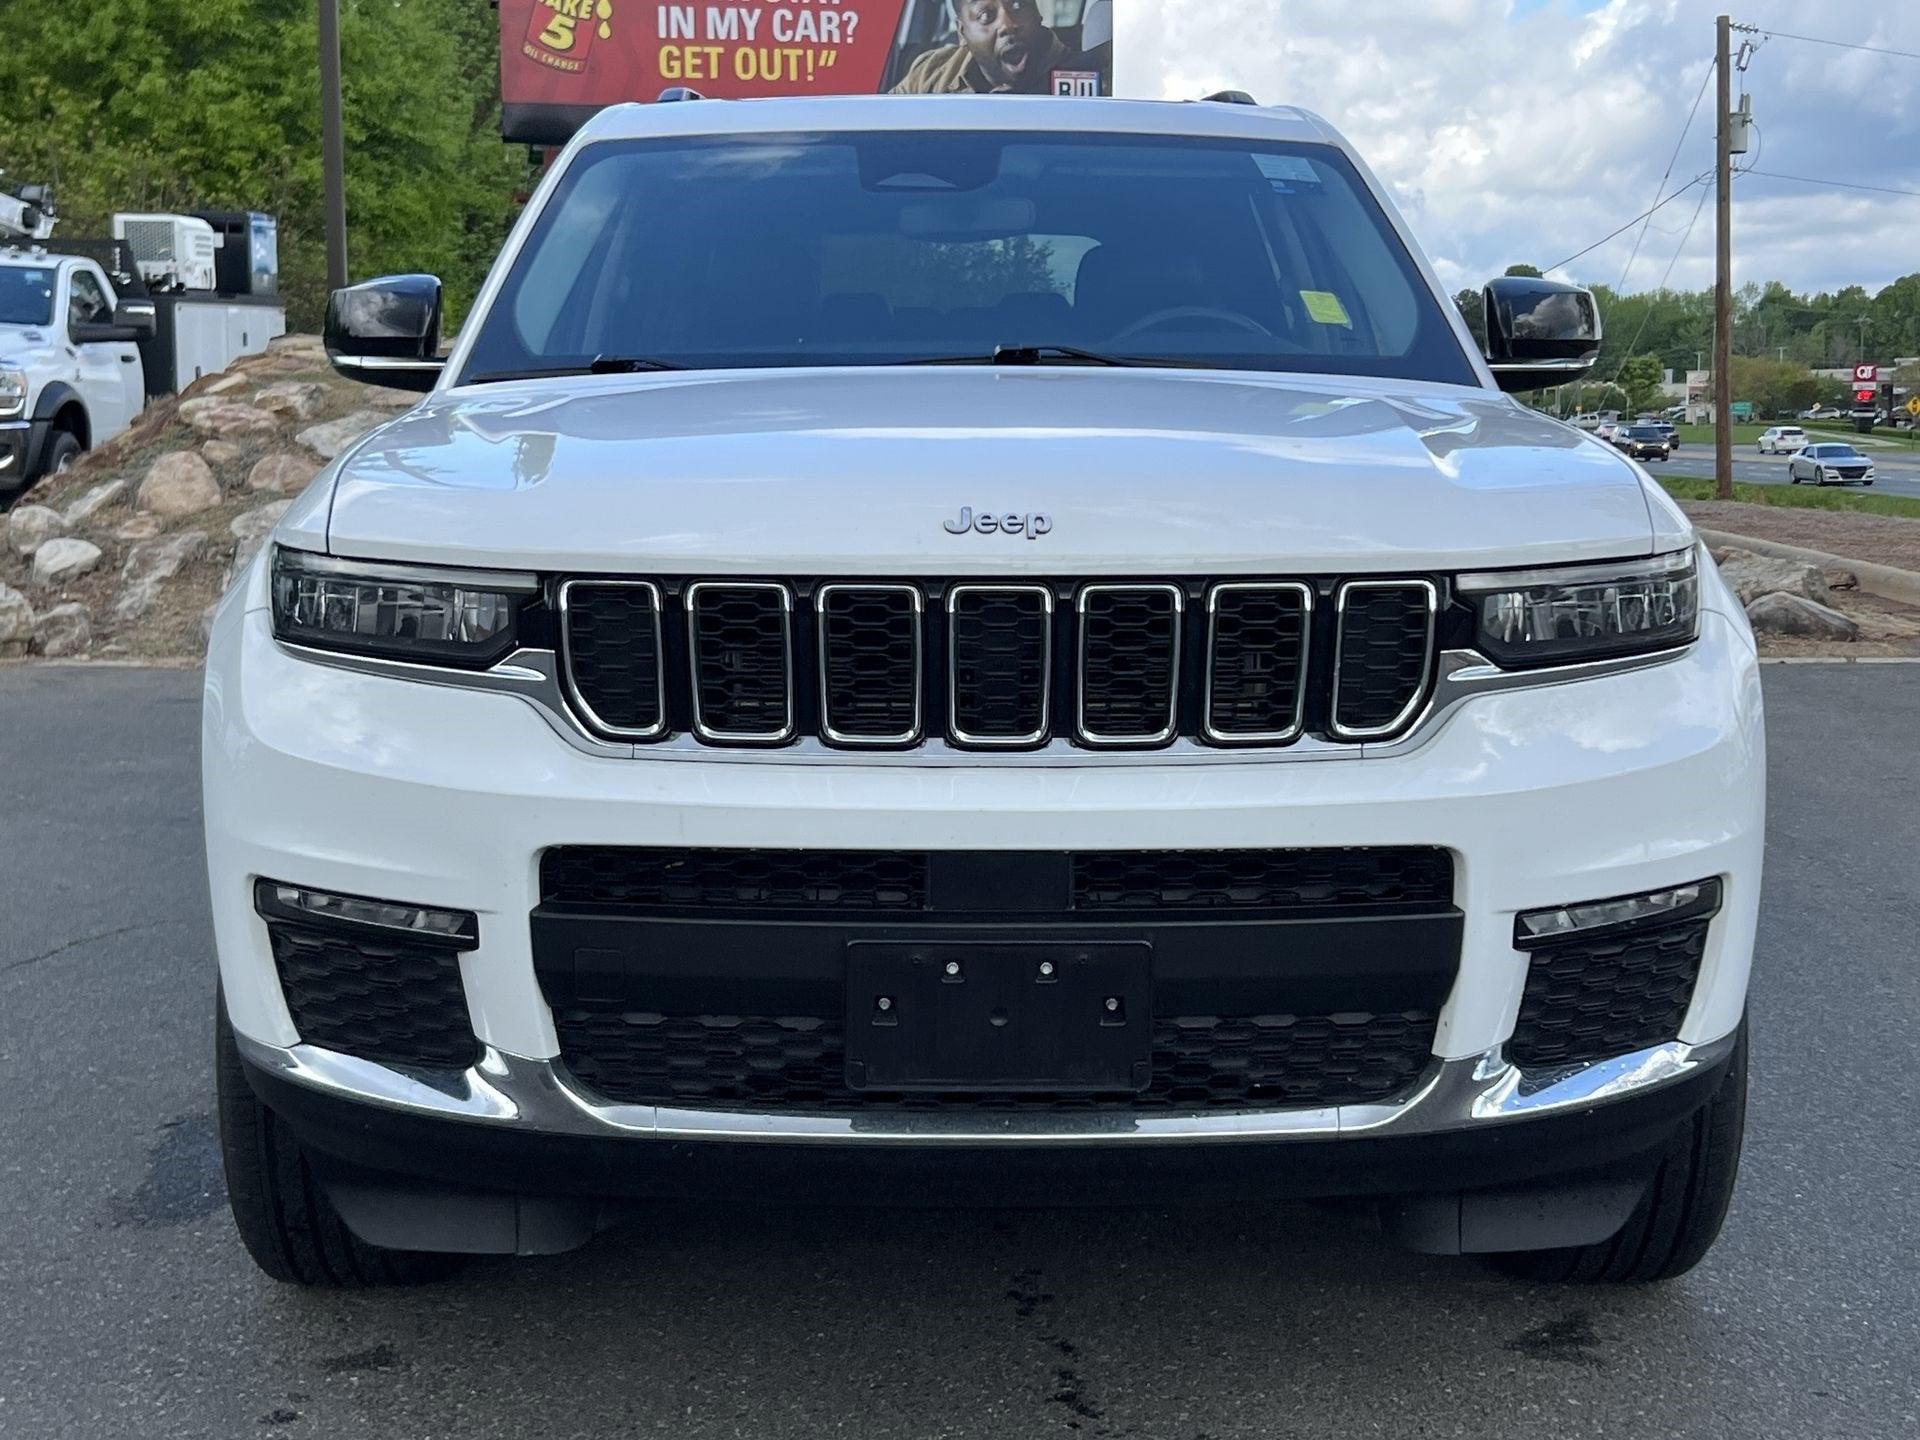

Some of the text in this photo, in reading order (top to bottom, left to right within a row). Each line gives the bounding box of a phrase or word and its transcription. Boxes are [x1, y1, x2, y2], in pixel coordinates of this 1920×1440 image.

[539, 13, 576, 50] 5
[657, 6, 859, 44] IN MY CAR?
[523, 44, 579, 71] OIL CHANGE
[659, 45, 724, 79] GET
[1856, 365, 1876, 379] QT
[943, 505, 1053, 541] Jeep
